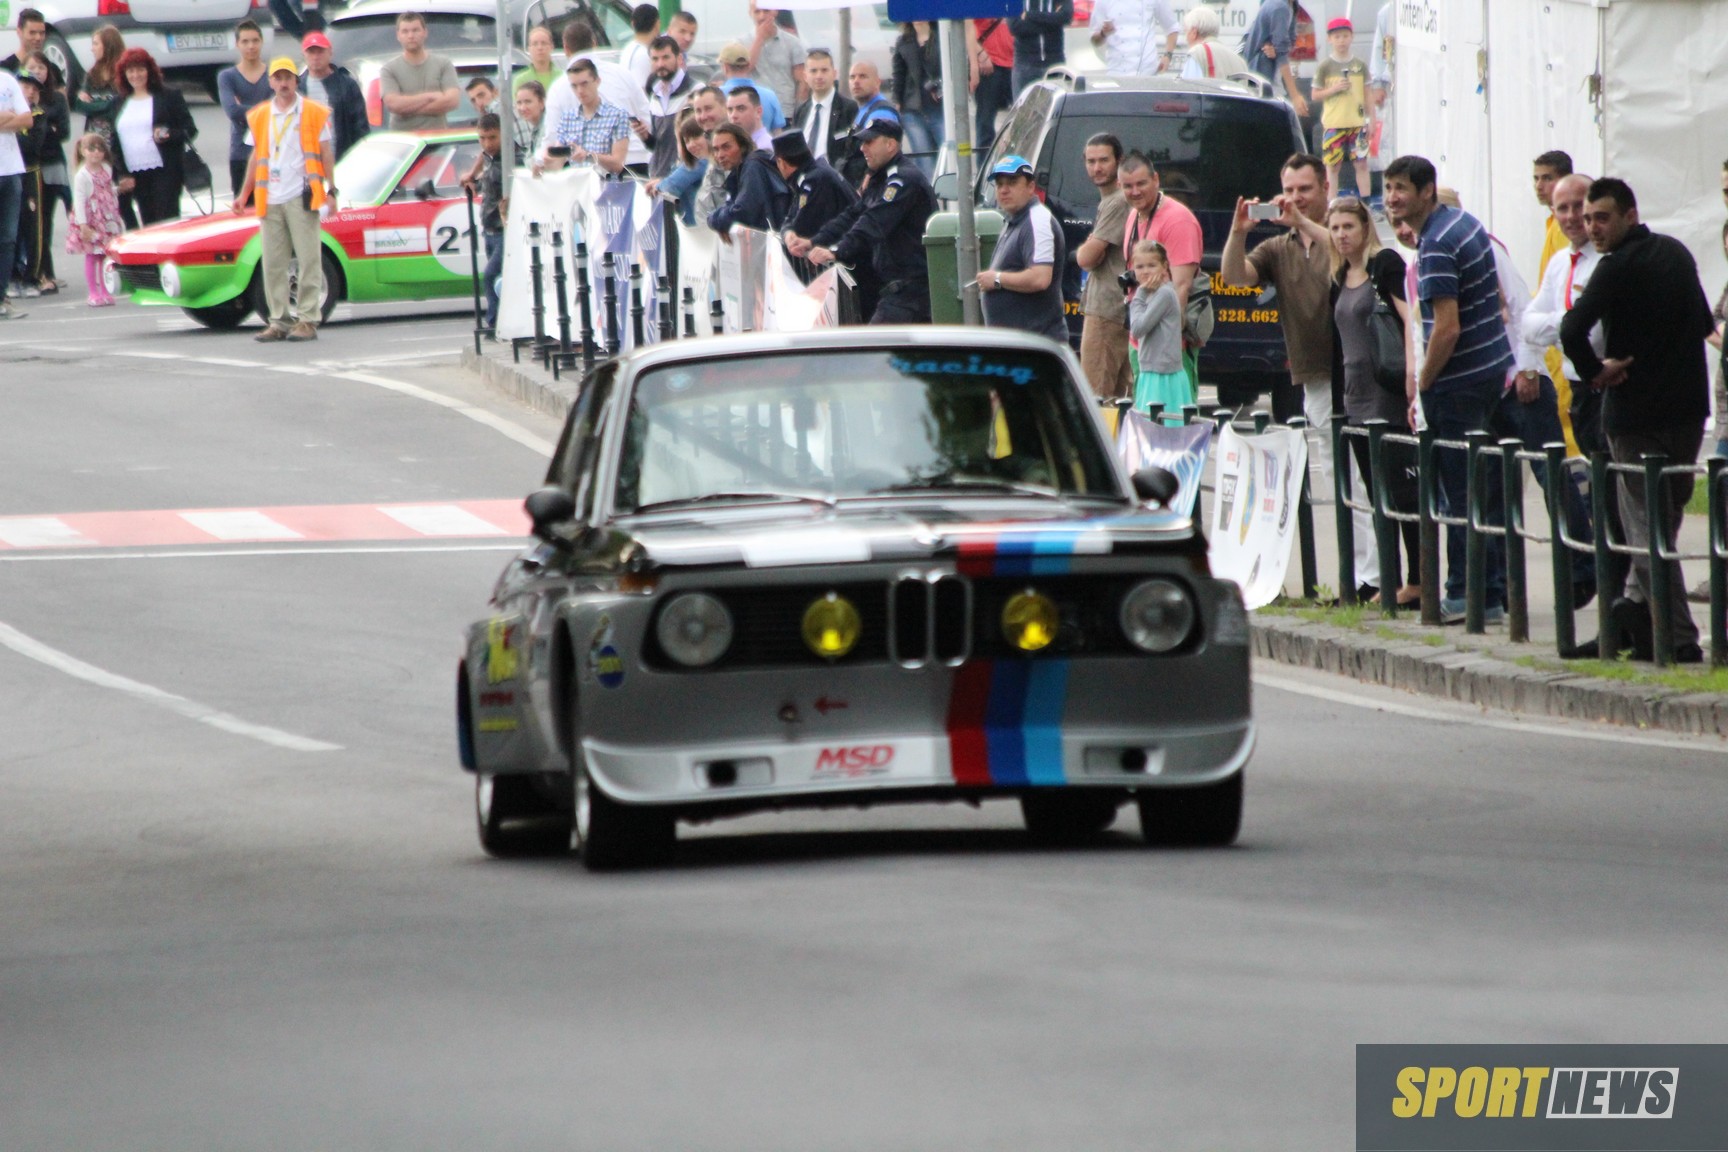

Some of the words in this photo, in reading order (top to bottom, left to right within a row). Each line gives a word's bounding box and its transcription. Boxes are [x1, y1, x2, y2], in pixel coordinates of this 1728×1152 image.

[436, 226, 480, 254] 21
[1218, 309, 1279, 323] 328.662
[887, 354, 1037, 385] racing
[815, 743, 895, 772] MSD
